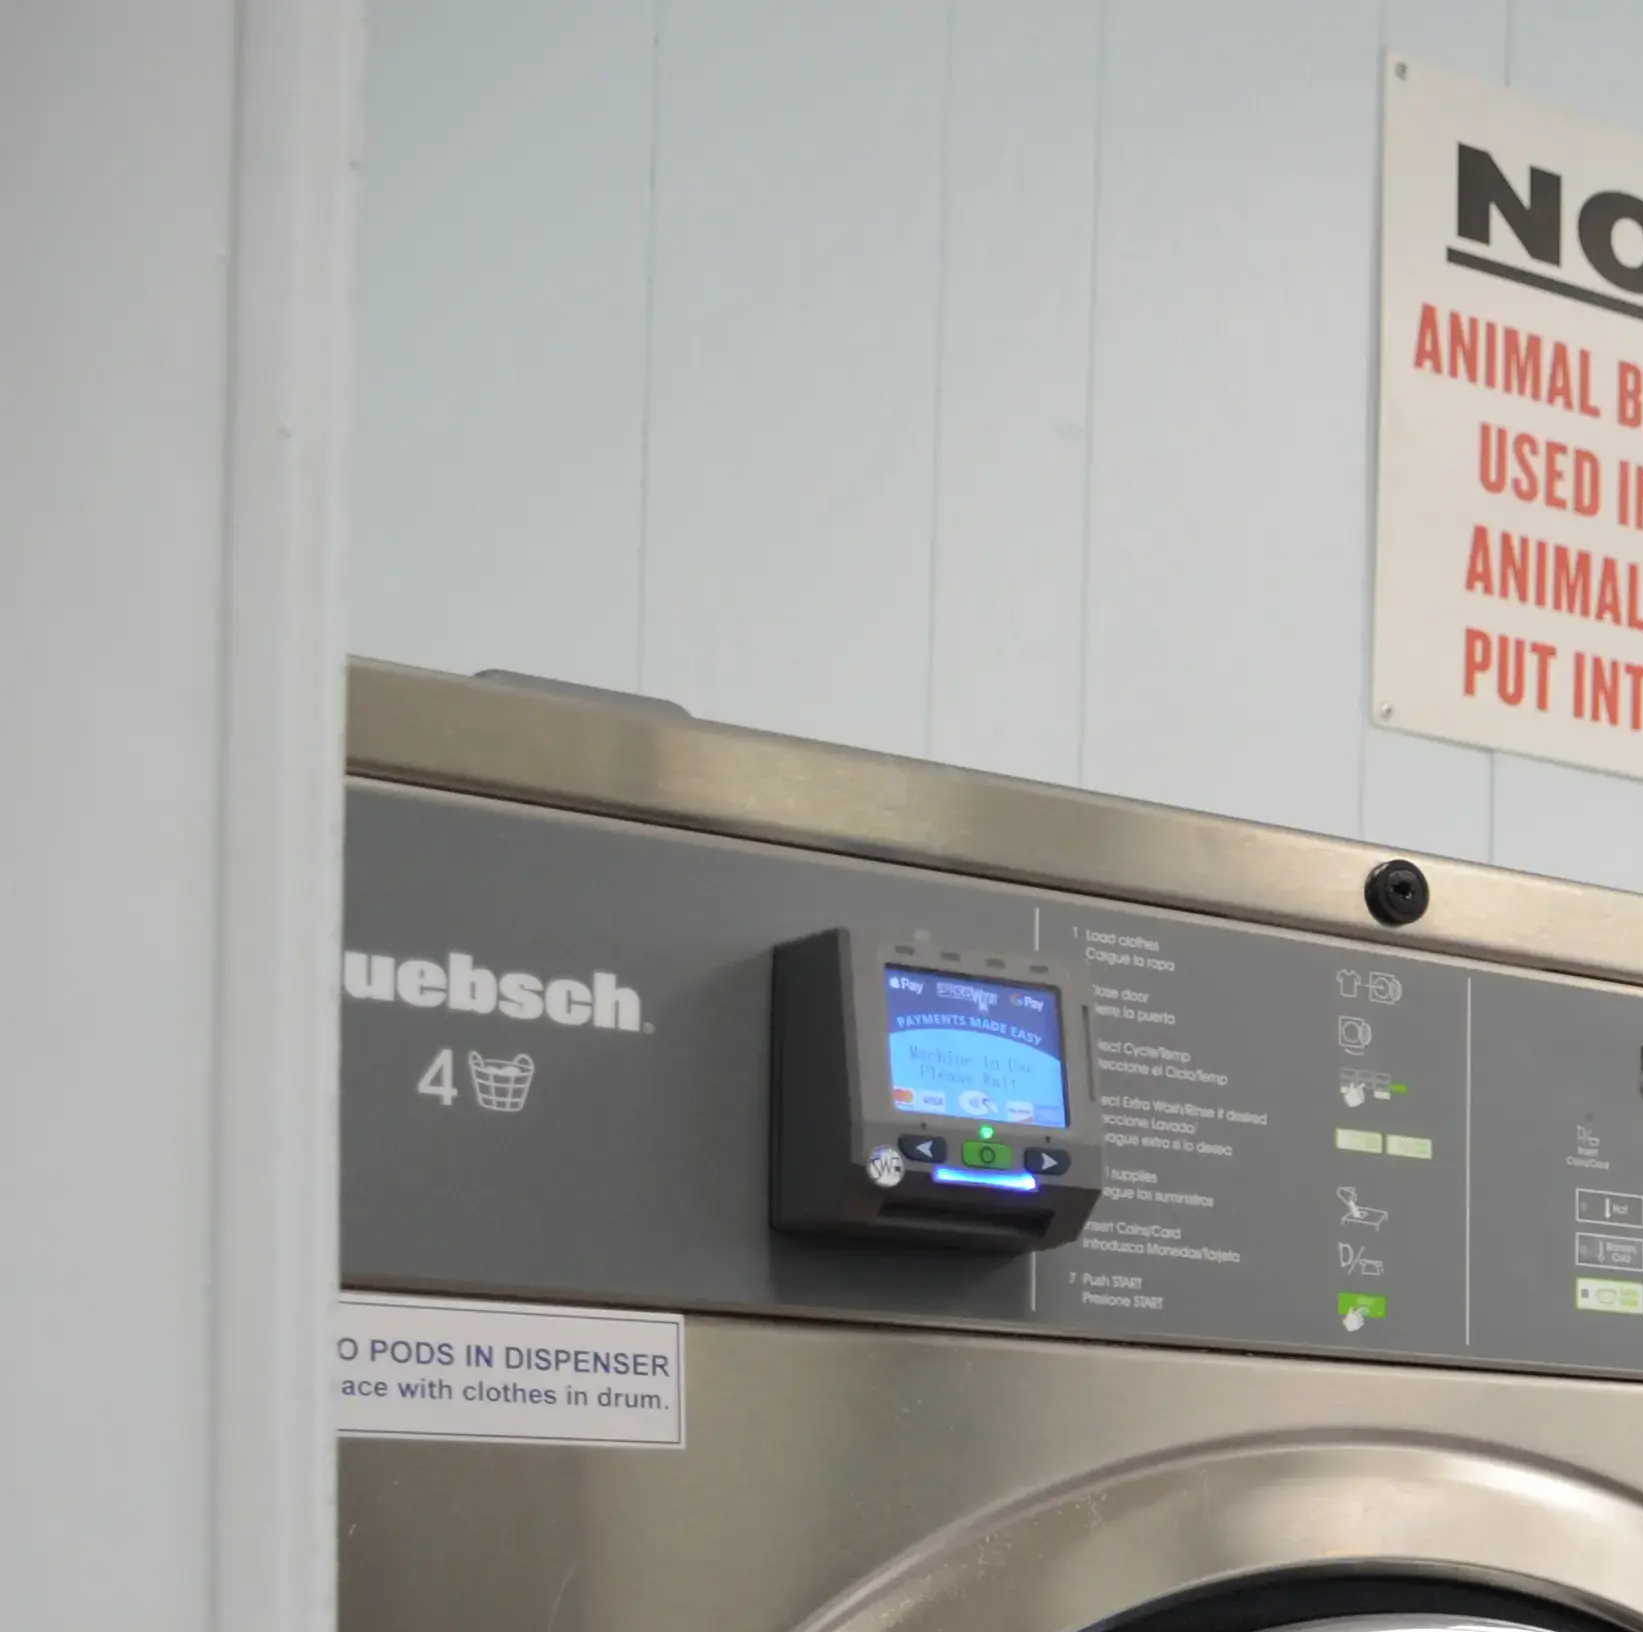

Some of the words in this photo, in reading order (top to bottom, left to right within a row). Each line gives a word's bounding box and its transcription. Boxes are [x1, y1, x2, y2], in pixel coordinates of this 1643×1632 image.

[1414, 303, 1600, 418] ANIMAL
[1478, 422, 1597, 516] USED
[1463, 628, 1556, 711] PUT
[1085, 928, 1116, 945] Load
[1118, 934, 1159, 952] clothes
[1085, 946, 1131, 966] Cargue
[1133, 953, 1144, 967] la
[344, 950, 641, 1033] uebsch
[900, 977, 925, 995] Pay
[1092, 984, 1118, 998] lose
[1121, 987, 1149, 1003] door
[1123, 1006, 1135, 1019] la
[1137, 1009, 1175, 1025] puerta
[897, 1013, 966, 1028] PAYMENTS
[970, 1016, 1007, 1034] MADE
[1011, 1026, 1042, 1046] EASY
[417, 1048, 458, 1106] 4
[920, 1064, 974, 1083] Please
[1122, 1095, 1150, 1111] Extra
[1141, 1136, 1170, 1149] extra
[1613, 1203, 1629, 1215] Hot
[1084, 1220, 1114, 1233] nsert
[1082, 1237, 1144, 1254] Introduzca
[1082, 1273, 1110, 1287] Push
[1112, 1275, 1142, 1290] START
[1082, 1291, 1131, 1308] Presione
[1133, 1296, 1164, 1310] START
[338, 1338, 359, 1362] O
[370, 1340, 454, 1367] PODS
[466, 1344, 493, 1368] IN
[505, 1346, 670, 1378] DISPENSER
[341, 1380, 388, 1398] ace
[398, 1379, 453, 1400] with
[463, 1381, 558, 1405] clothes
[567, 1385, 588, 1406] in
[597, 1387, 669, 1411] drum.
